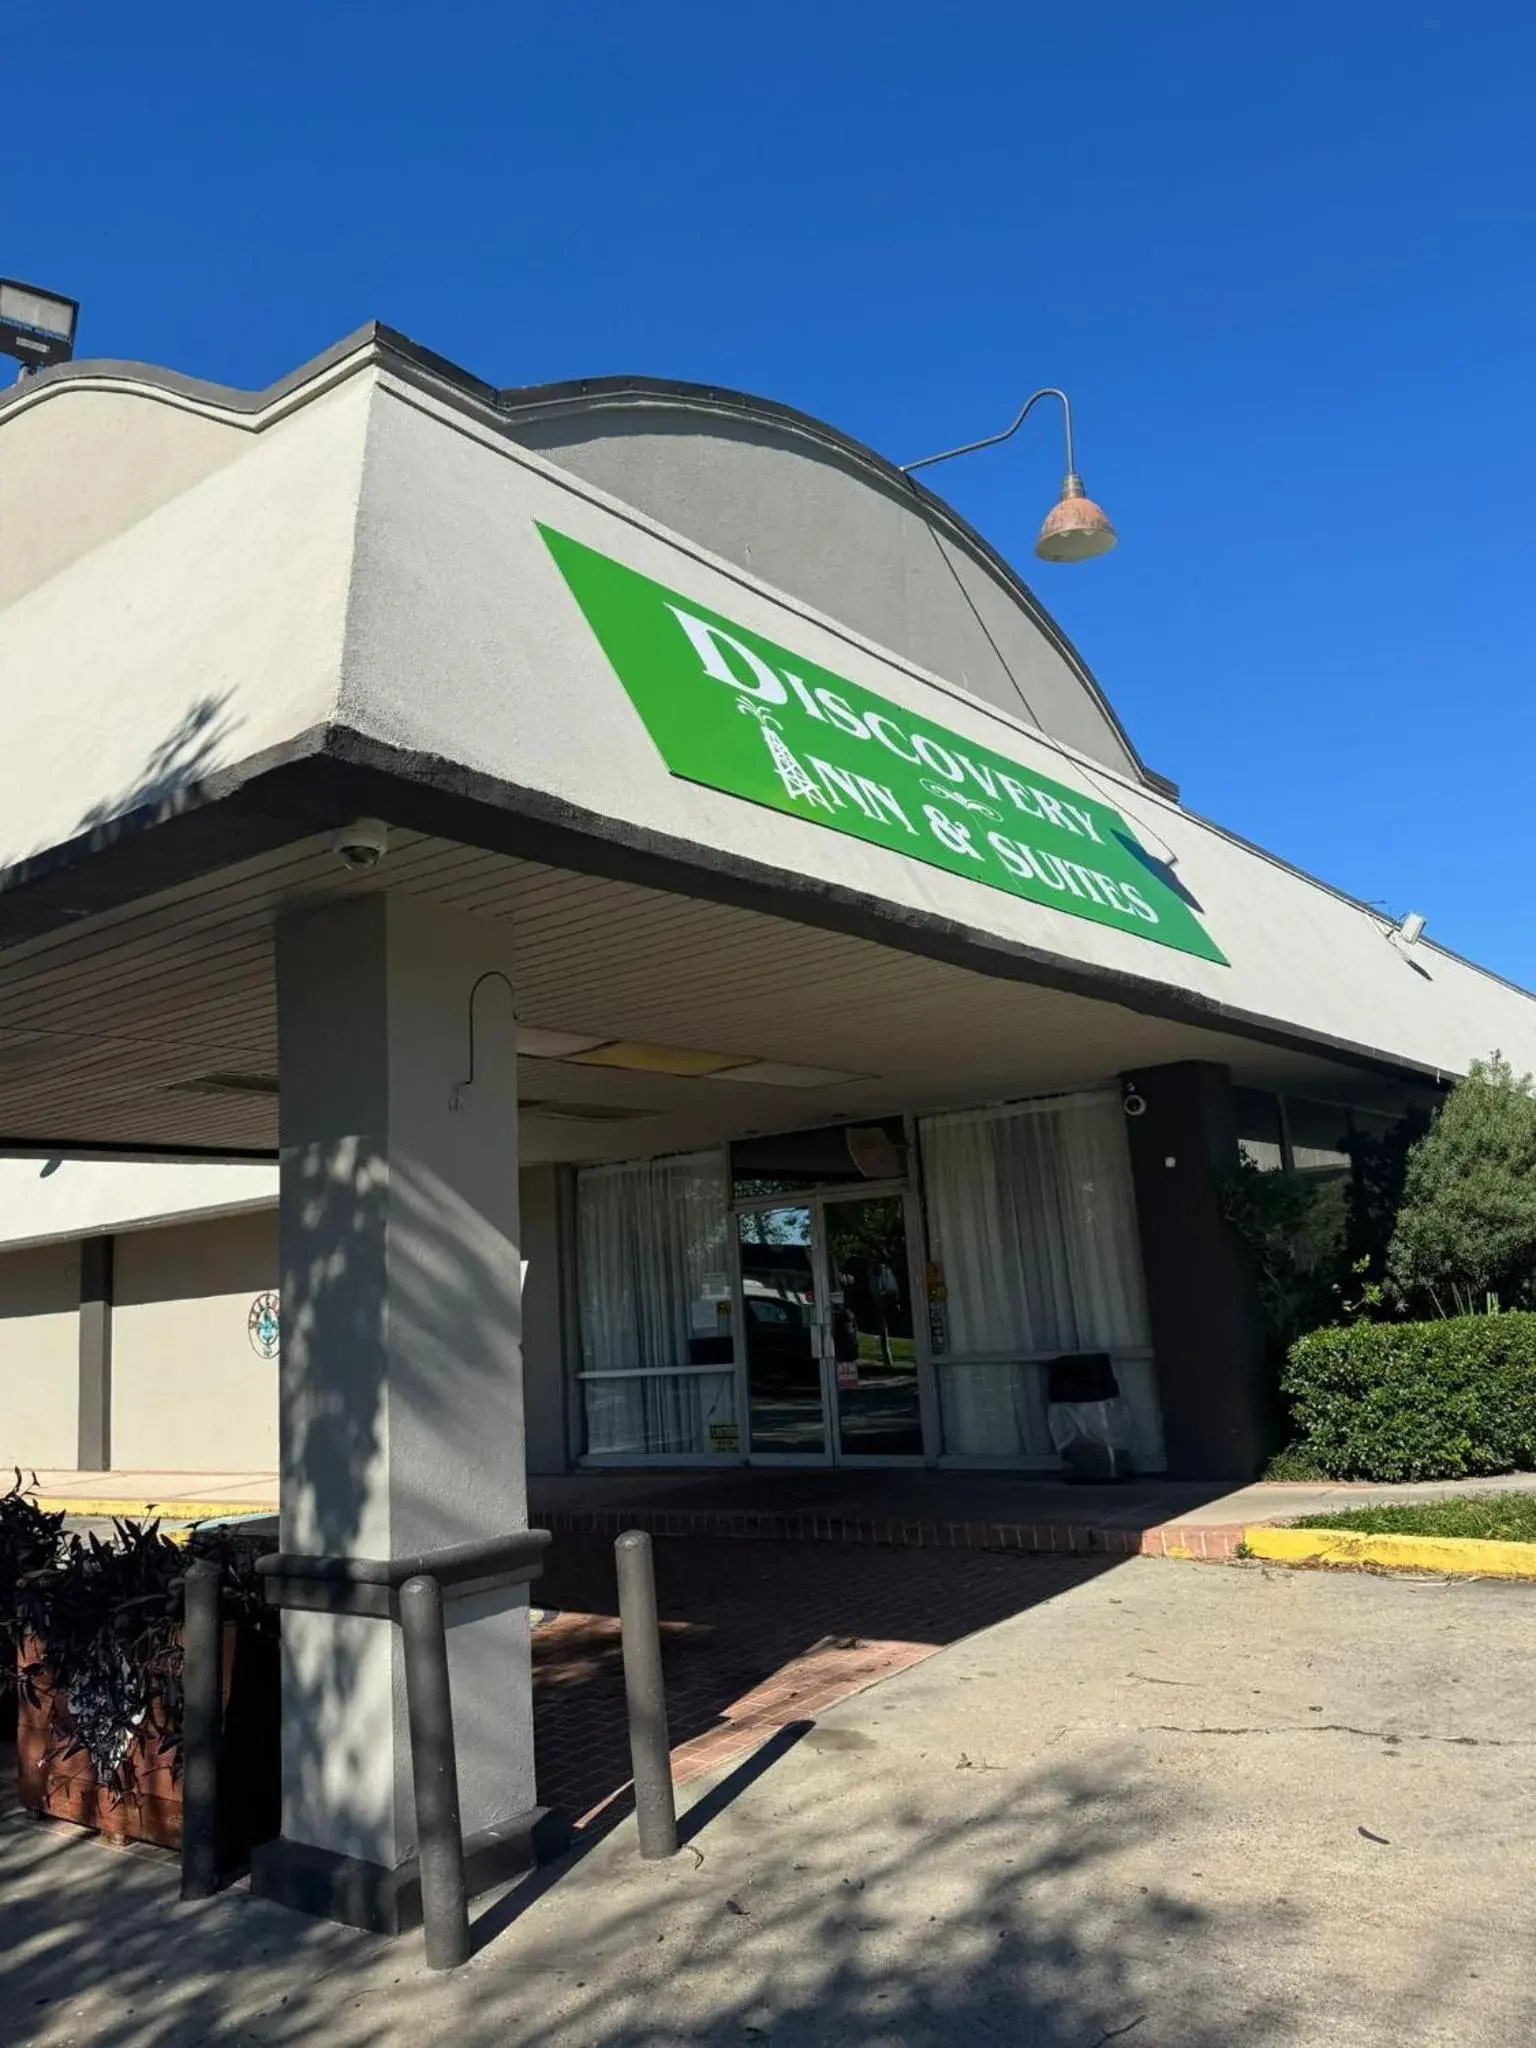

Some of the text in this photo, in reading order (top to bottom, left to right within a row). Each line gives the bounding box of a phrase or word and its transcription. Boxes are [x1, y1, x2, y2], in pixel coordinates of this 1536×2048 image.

[664, 602, 1105, 844] DISCOVERY
[922, 804, 985, 861] &
[987, 831, 1159, 924] SUITES
